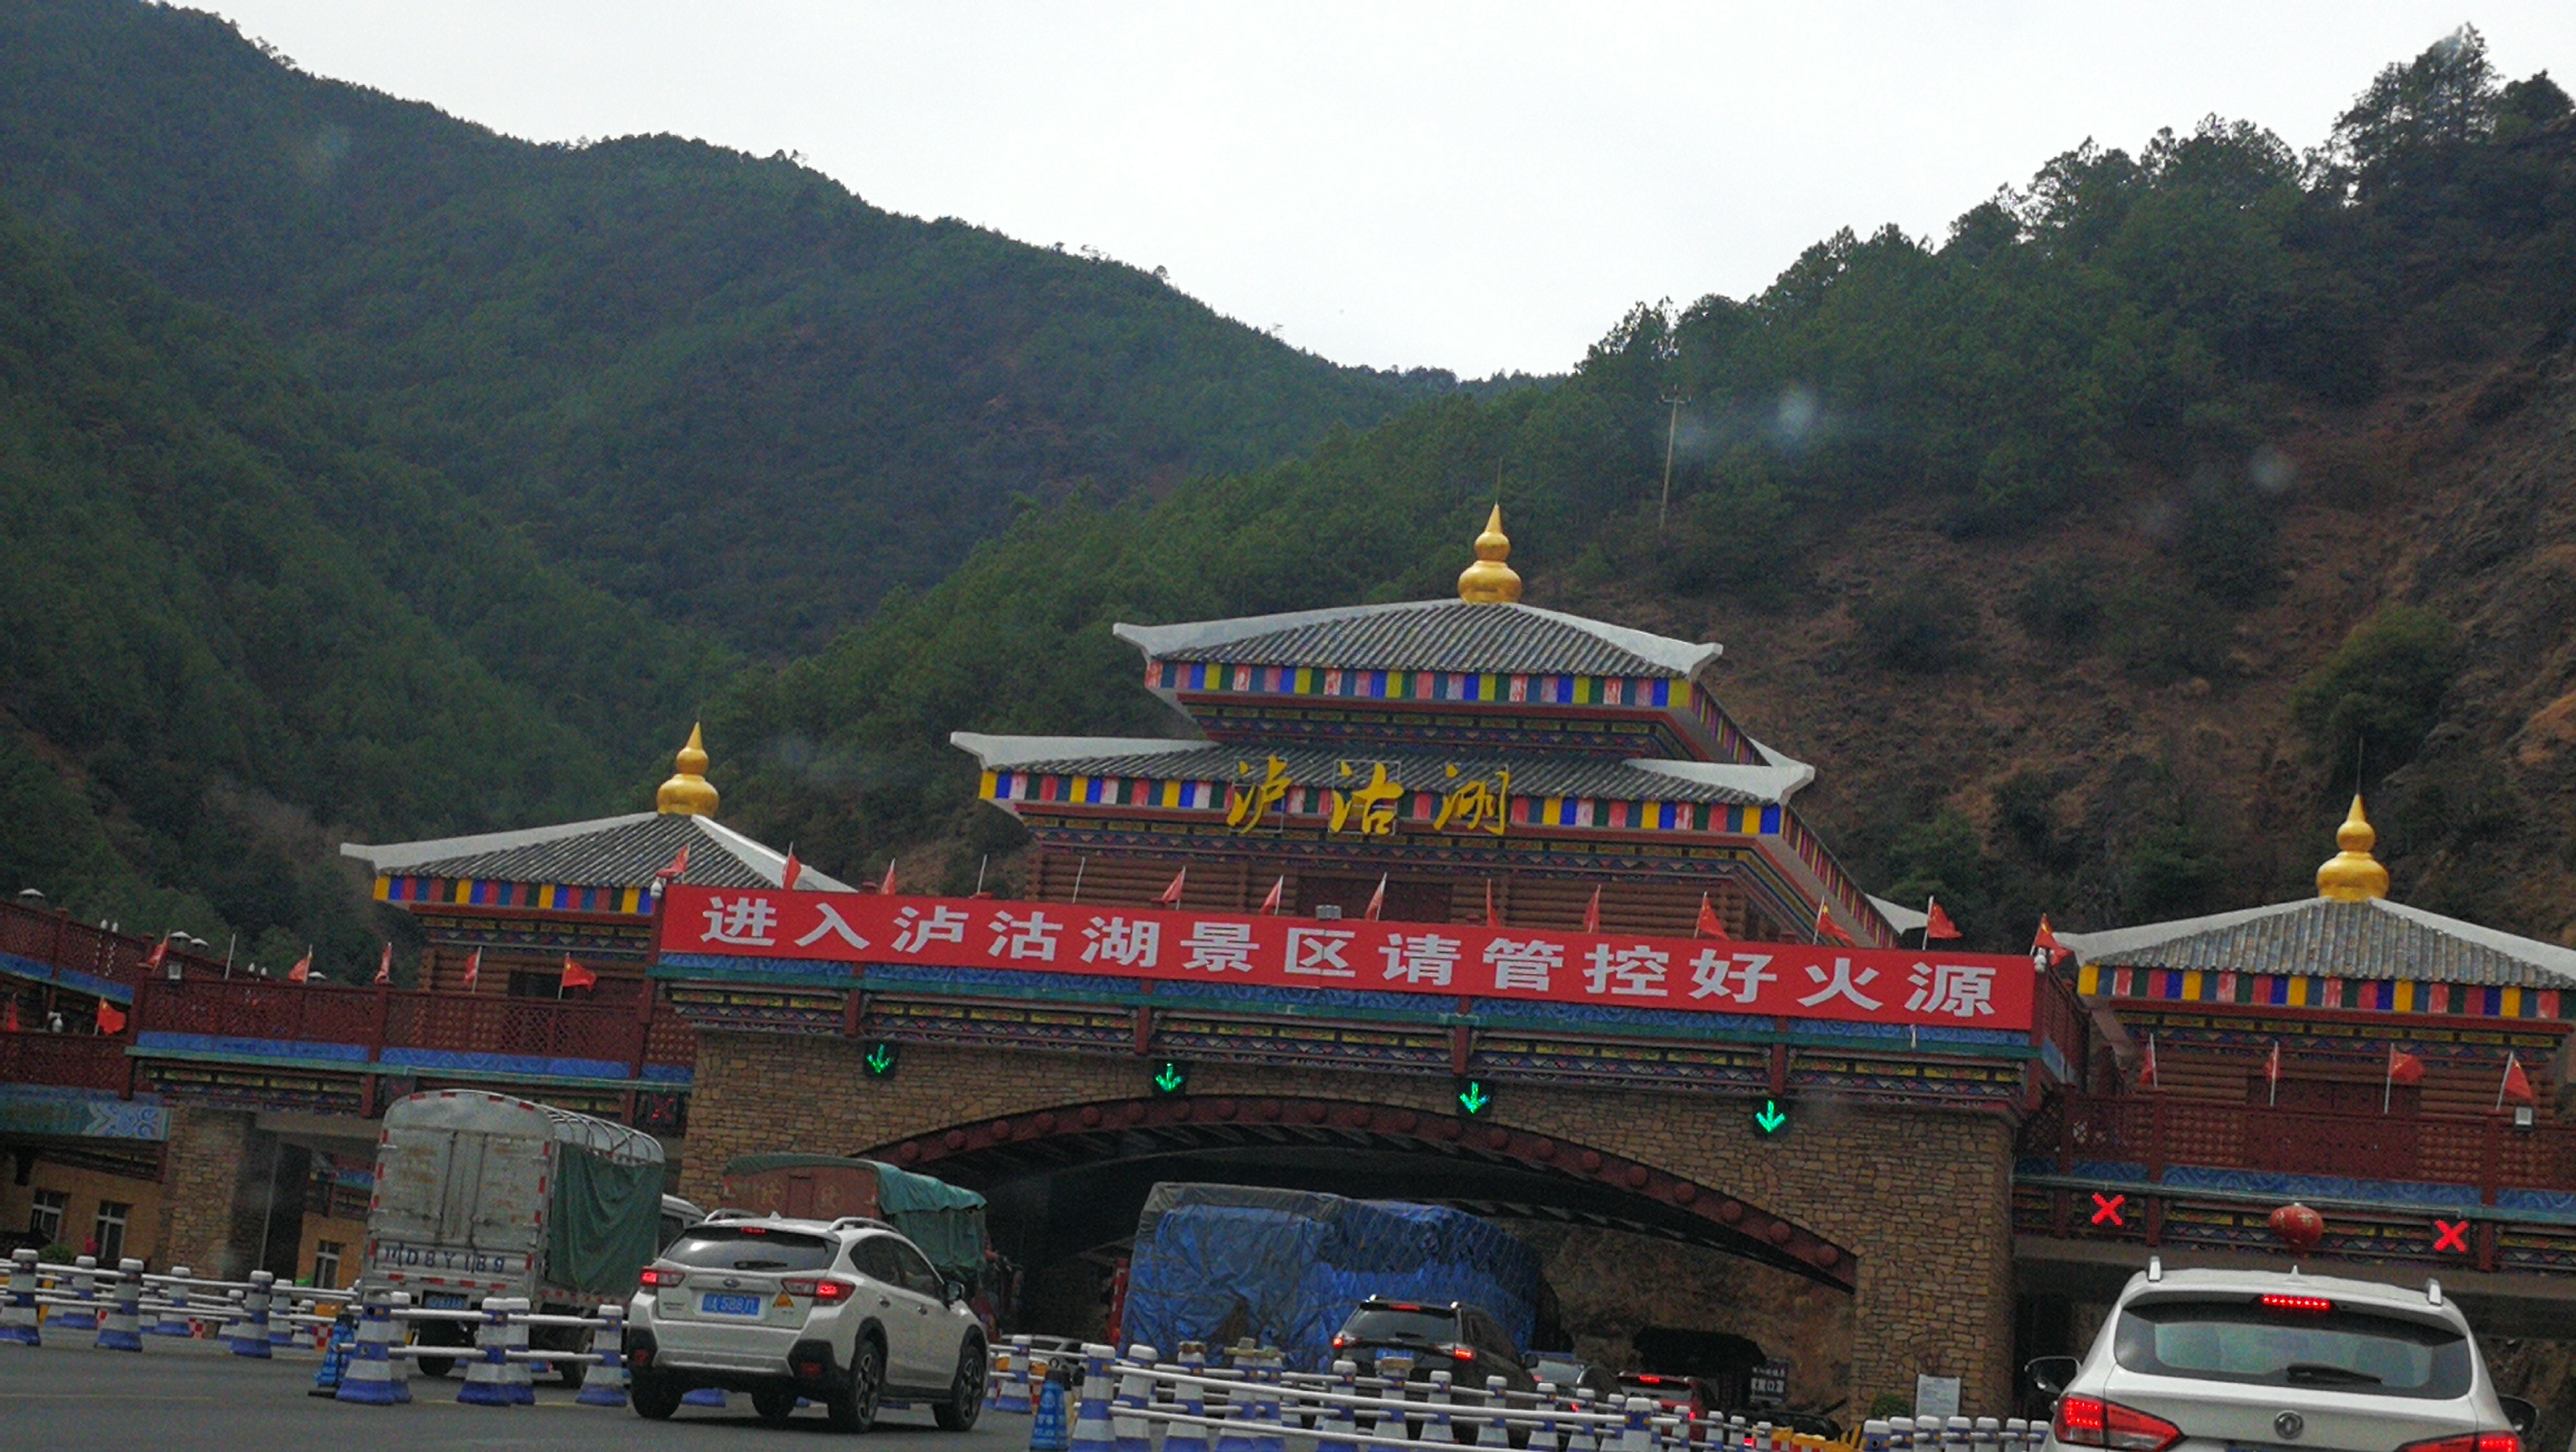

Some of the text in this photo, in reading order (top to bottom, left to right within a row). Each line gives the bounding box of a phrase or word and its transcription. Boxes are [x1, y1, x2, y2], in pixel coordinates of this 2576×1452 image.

[1226, 754, 1510, 836] 泸沽湖
[699, 896, 1998, 1019] 进入泸沽湖景区请管控好火源
